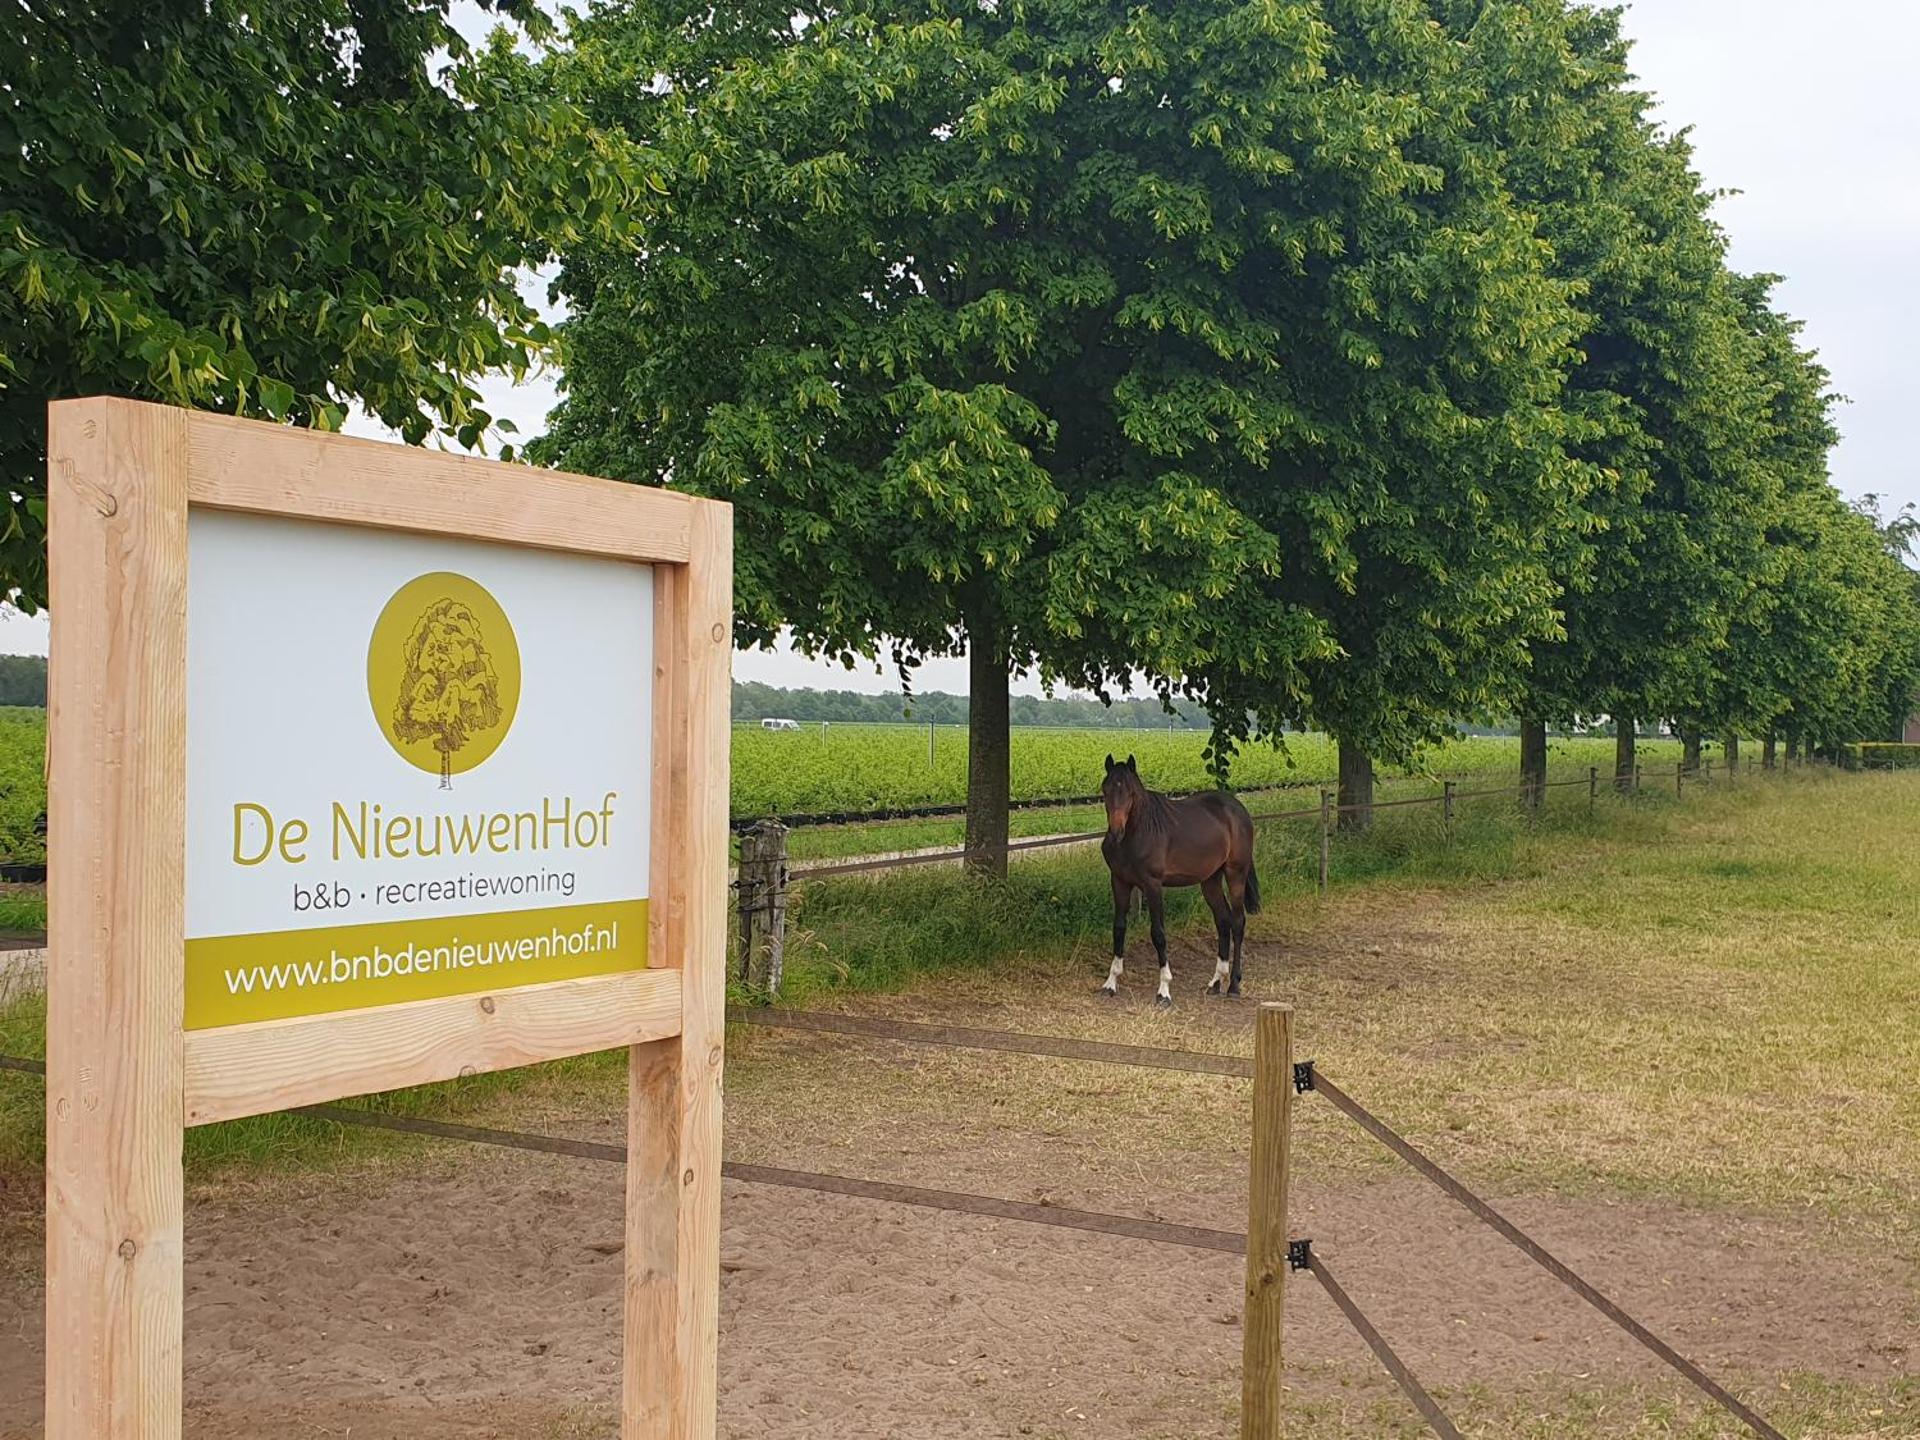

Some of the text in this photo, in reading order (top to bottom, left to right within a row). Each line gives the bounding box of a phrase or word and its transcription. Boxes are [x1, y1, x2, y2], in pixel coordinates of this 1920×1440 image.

[232, 792, 617, 866] De NieuwenHof
[293, 867, 576, 911] b&b recreatiewoning
[224, 921, 618, 995] www.bnbdenieuwenhof.nl
